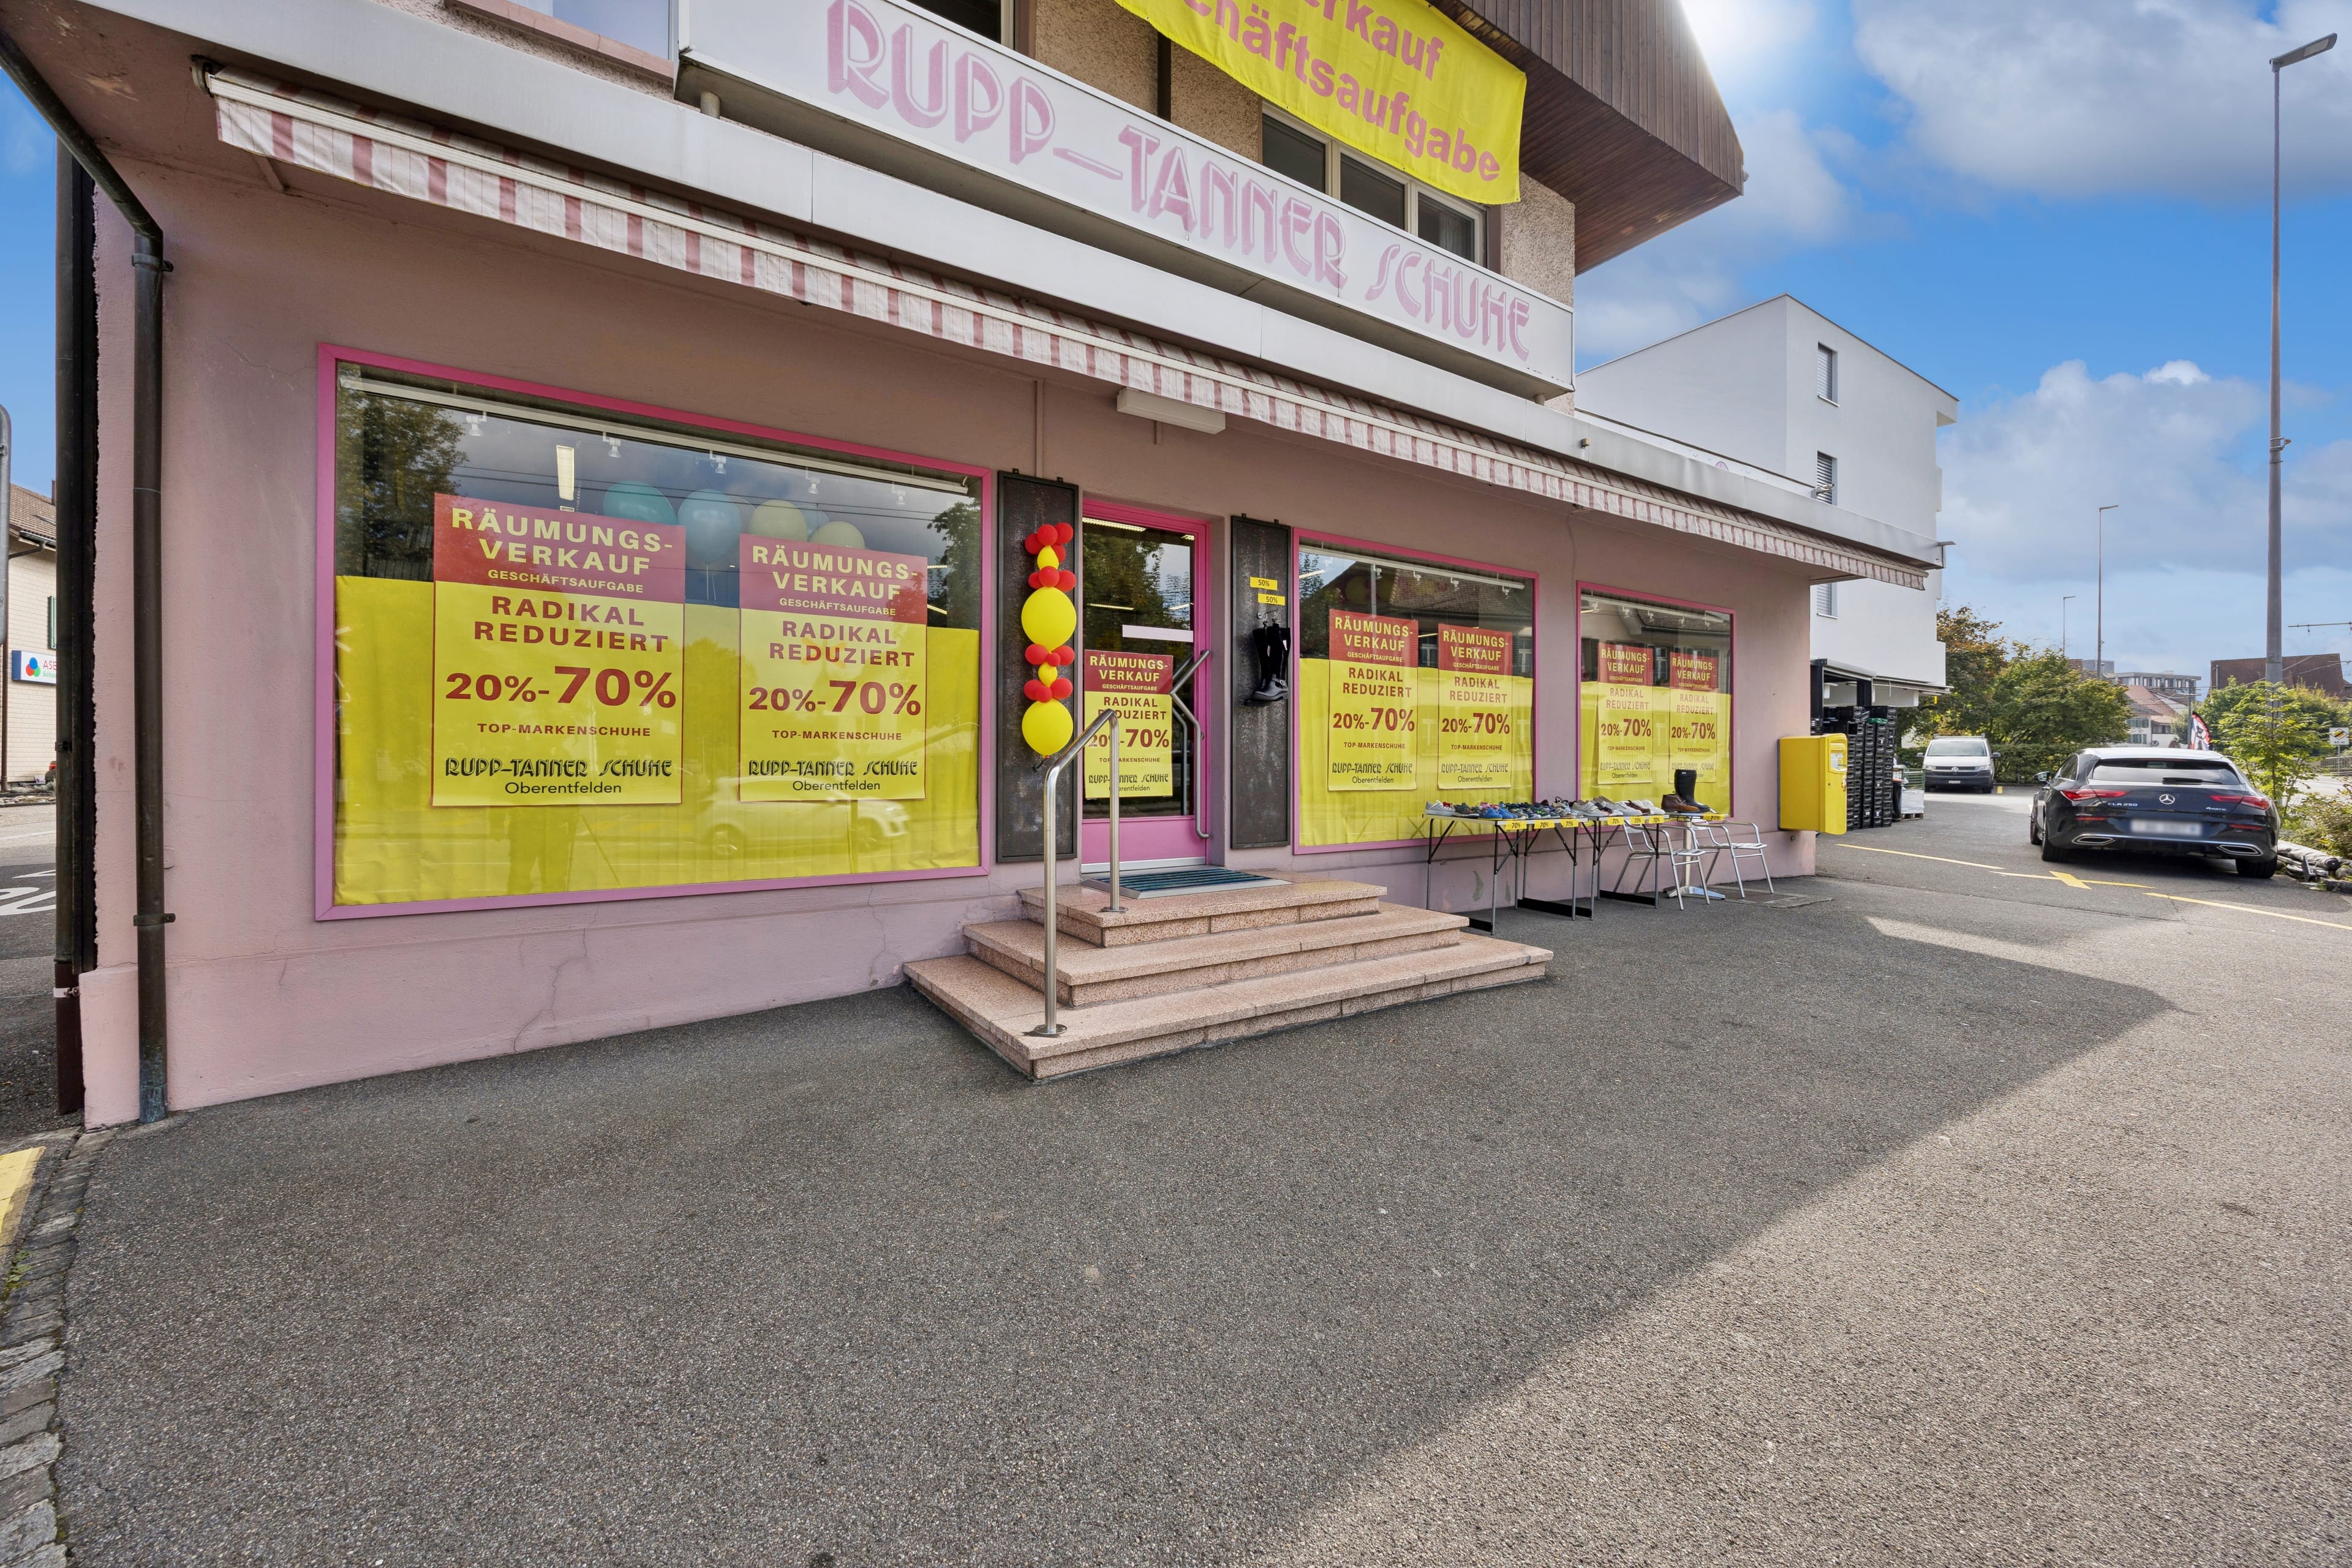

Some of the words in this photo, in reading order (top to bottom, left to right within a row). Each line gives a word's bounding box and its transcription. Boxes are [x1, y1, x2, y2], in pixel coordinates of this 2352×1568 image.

[1303, 0, 1444, 81] rkauf
[1364, 244, 1529, 361] SCHUHE
[452, 507, 673, 552] RÄUMUNGS-
[479, 538, 651, 575] VERKAUF
[752, 545, 918, 578] RÄUMUNGS-
[488, 569, 644, 594] GESCHÄFTSAUFGABE
[772, 571, 900, 600] VERKAUF
[492, 595, 644, 626] RADIKAL
[779, 597, 896, 616] GESCHÄFTSAUFGABE
[782, 620, 897, 645] RADIKAL
[1335, 616, 1413, 638] RÄUMUNGS-
[475, 621, 668, 652] REDUZIERT
[1344, 634, 1405, 652] VERKAUF
[1442, 629, 1509, 648] RÄUMUNGS-
[769, 643, 915, 667] REDUZIERT
[1347, 650, 1403, 663] GESCHÄFTSAUFGABE
[1450, 645, 1502, 662] VERKAUF
[1601, 647, 1650, 663] RÄUMUNGS-
[1090, 655, 1168, 670] RÄUMUNGS-
[1453, 662, 1499, 671] GESCHÄFTSAUFGABE
[1607, 662, 1645, 674] VERKAUF
[1672, 657, 1714, 671] RÄUMUNGS-
[1099, 669, 1160, 682] VERKAUF
[1348, 667, 1403, 682] RADIKAL
[1677, 669, 1711, 681] VERKAUF
[1343, 682, 1412, 698] REDUZIERT
[1454, 676, 1500, 690] RADIKAL
[1449, 690, 1507, 704] REDUZIERT
[1610, 687, 1644, 698] RADIKAL
[1679, 693, 1709, 704] RADIKAL
[1104, 696, 1158, 707] RADIKAL
[1606, 699, 1649, 710] REDUZIERT
[1098, 709, 1167, 720] DUZIERT
[1676, 705, 1714, 715] REDUZIERT
[477, 723, 651, 737] TOP-MARKENSCHUHE
[772, 730, 902, 741] TOP-MARKENSCHUHE
[1088, 729, 1169, 748] 20-70%
[445, 758, 588, 777] RUPP-TANNER
[599, 759, 673, 777] SCHUHE
[748, 760, 855, 776] RUPP-TANNER
[863, 760, 918, 776] SCHUHE
[1332, 762, 1381, 774] RUPP-TANNER
[1385, 763, 1412, 774] SCHUHE
[1441, 763, 1482, 774] RUPP-TANNER
[1485, 763, 1509, 773] SCHUHE
[793, 780, 880, 791] Oberentfelden
[1088, 774, 1137, 783] RUPP-NNER
[1141, 774, 1169, 783] SCHUHE
[1352, 775, 1394, 784] Oberentfelden
[505, 782, 622, 794] Oberentfelden
